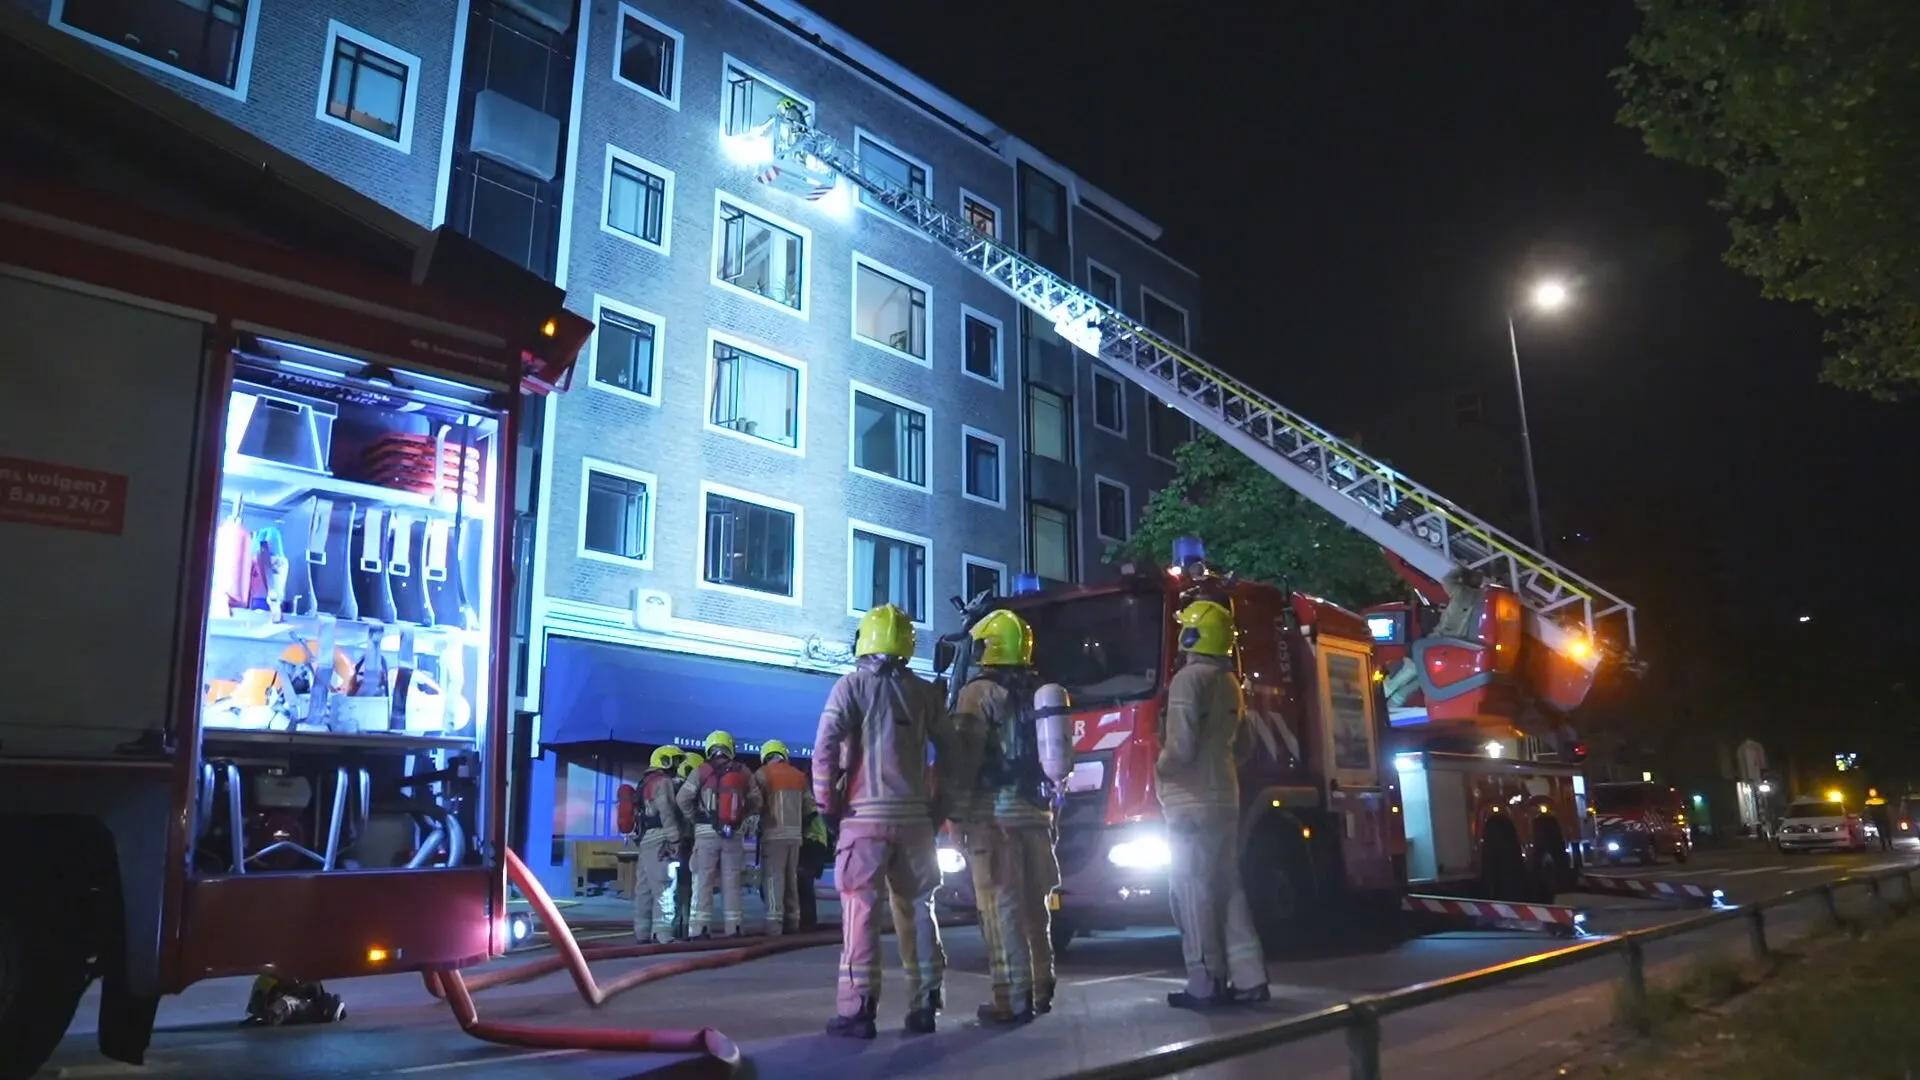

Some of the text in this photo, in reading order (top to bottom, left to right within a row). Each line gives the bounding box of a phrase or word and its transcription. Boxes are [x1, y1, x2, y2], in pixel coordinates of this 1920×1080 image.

[27, 472, 108, 495] volgen?
[10, 486, 111, 514] Baan 24/7
